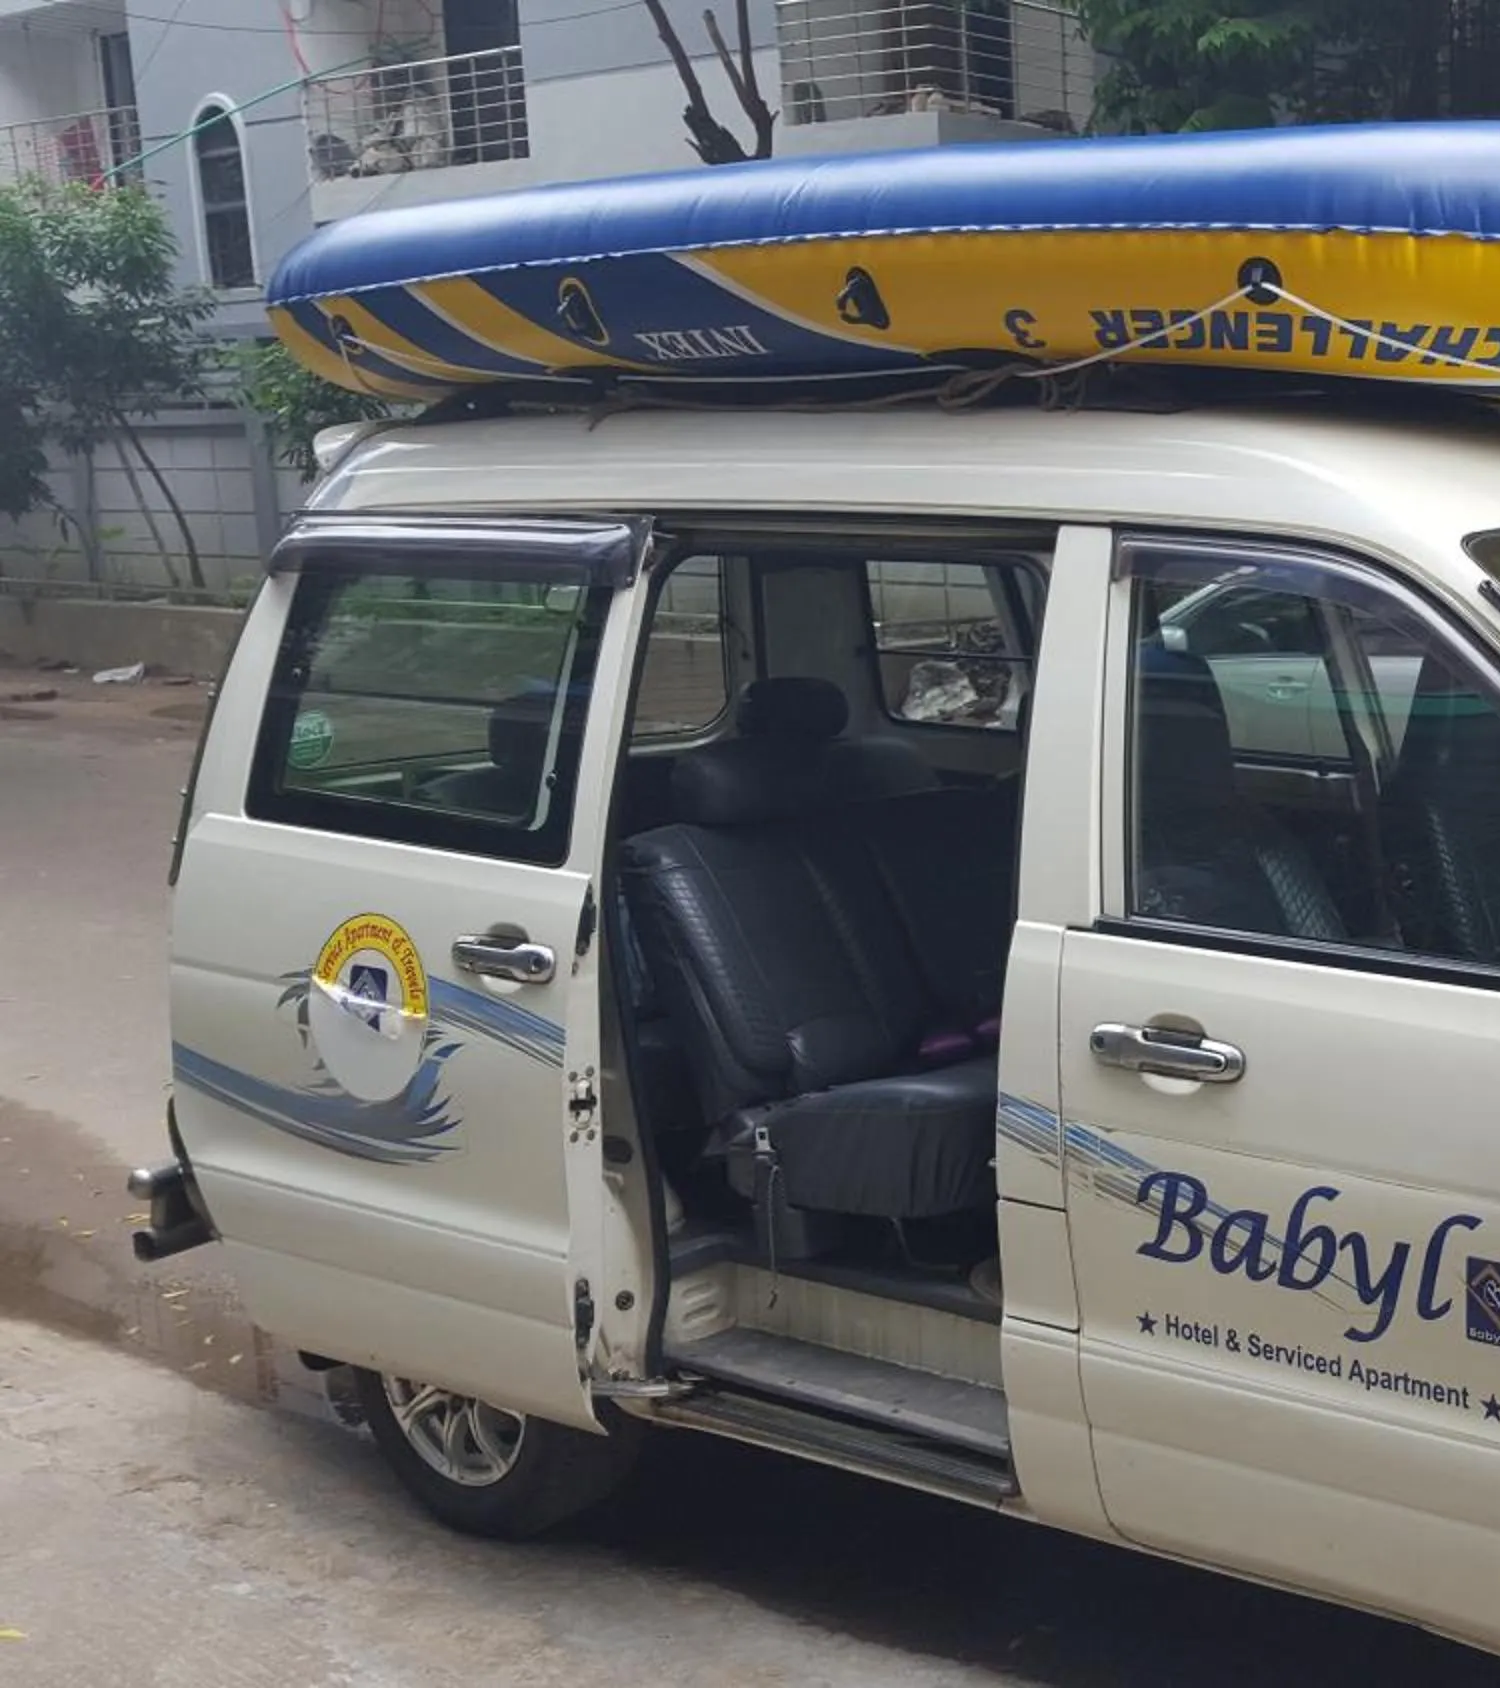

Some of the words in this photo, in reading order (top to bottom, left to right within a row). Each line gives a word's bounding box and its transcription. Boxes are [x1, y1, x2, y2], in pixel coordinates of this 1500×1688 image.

[632, 325, 769, 361] INTEX
[1004, 309, 1046, 349] 3
[1165, 1313, 1218, 1347] Hotel
[1225, 1328, 1241, 1352] &
[1247, 1333, 1341, 1377] Serviced
[1348, 1359, 1469, 1409] Apartment
